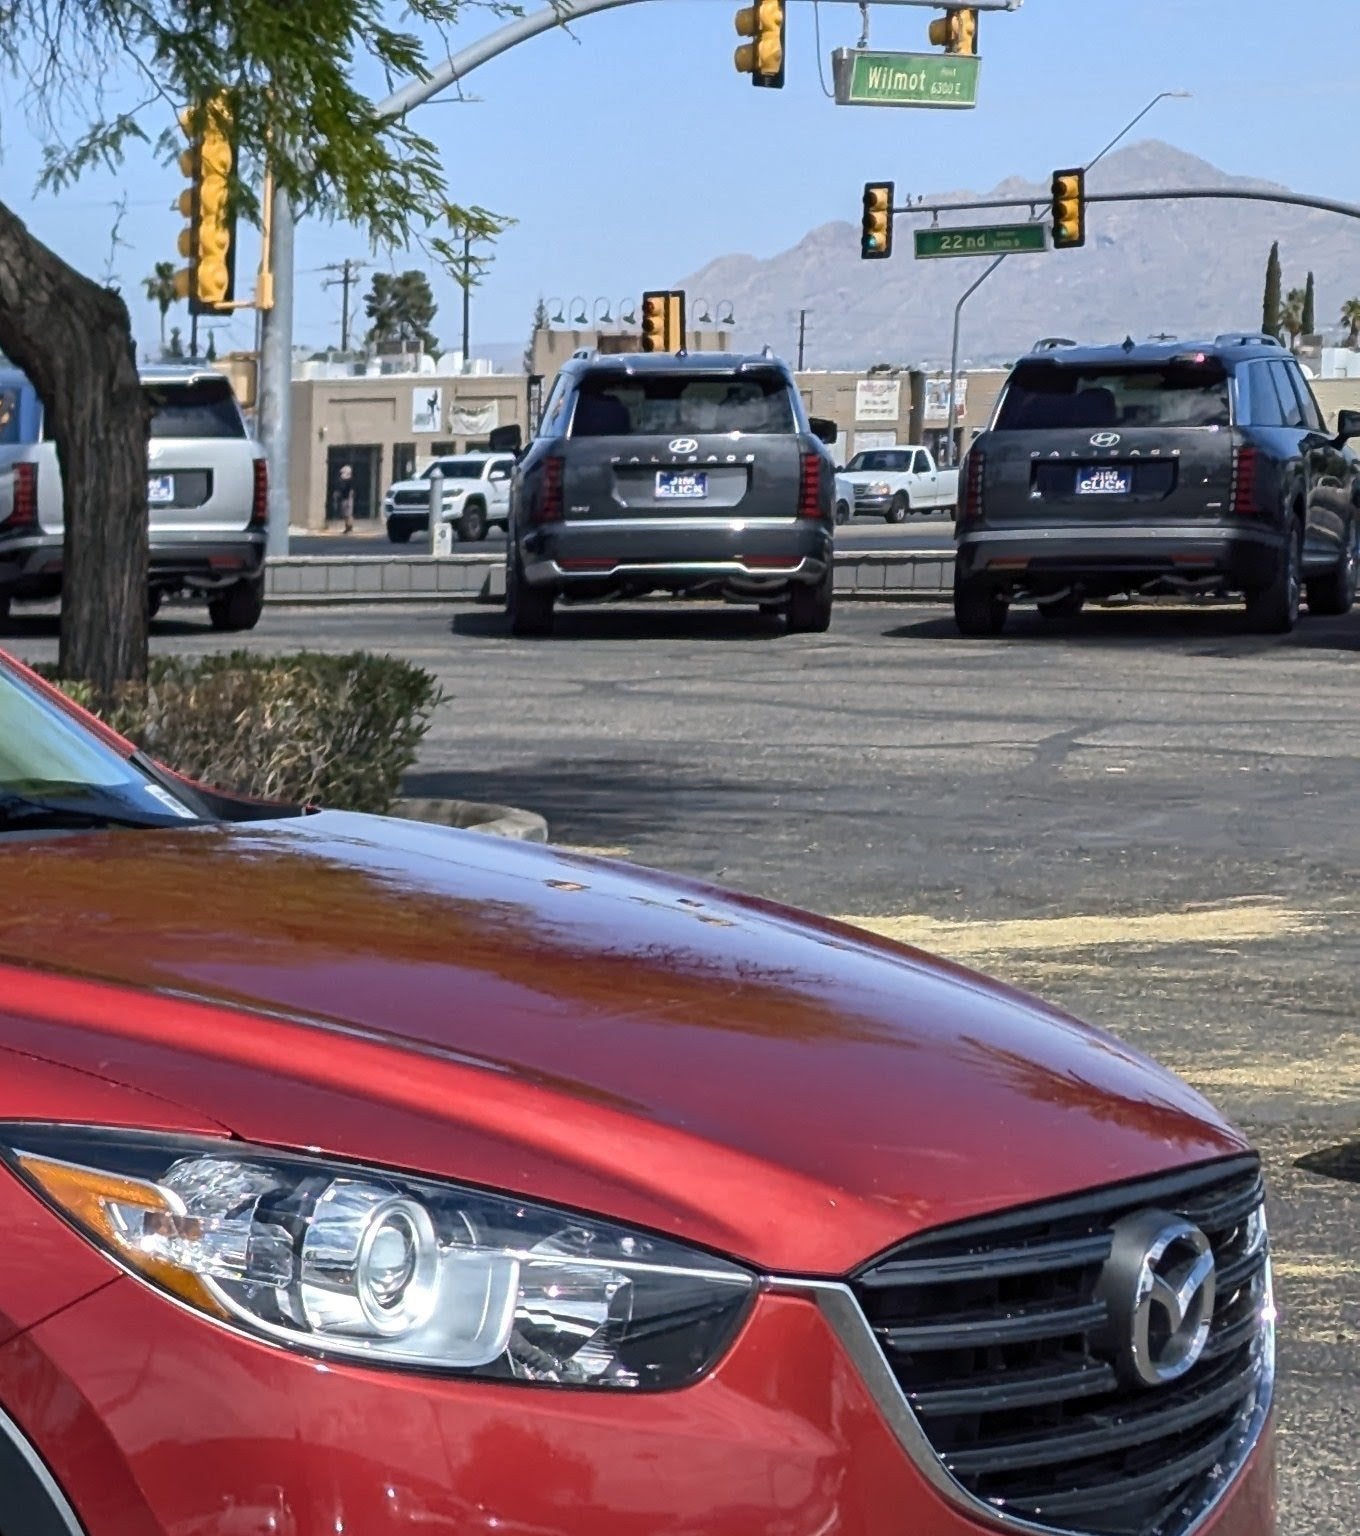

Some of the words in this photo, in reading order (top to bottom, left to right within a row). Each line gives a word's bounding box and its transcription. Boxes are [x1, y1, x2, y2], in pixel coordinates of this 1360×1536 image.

[868, 66, 927, 92] Wilmot
[940, 233, 986, 250] 22nd
[610, 454, 755, 464] PALISADE
[670, 475, 697, 486] JIM
[1091, 470, 1119, 482] JIM
[660, 484, 705, 495] CLICK
[1080, 479, 1126, 491] CLICK
